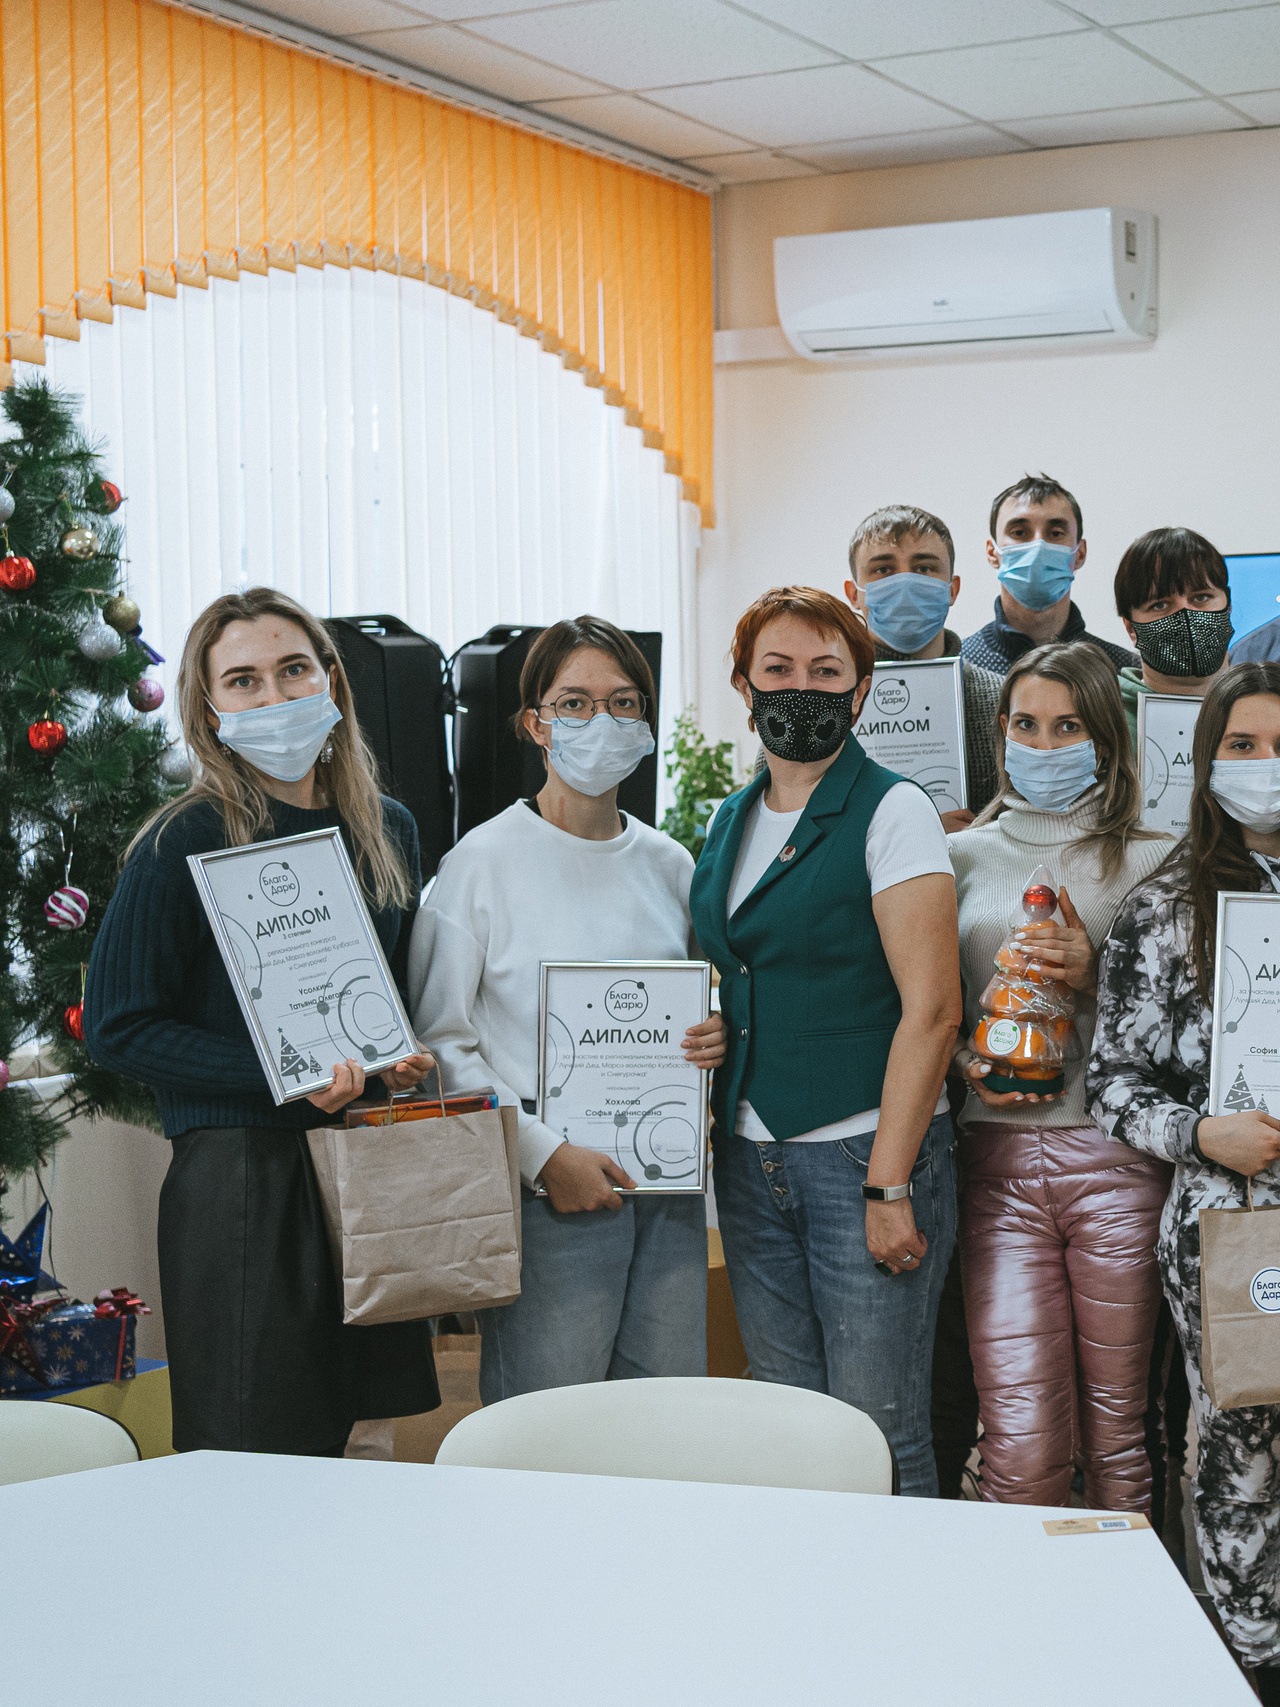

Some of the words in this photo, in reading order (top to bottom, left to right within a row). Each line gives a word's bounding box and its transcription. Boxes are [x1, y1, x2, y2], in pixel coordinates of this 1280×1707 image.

[877, 689, 901, 697] Благо
[881, 697, 906, 705] Дарю
[856, 719, 930, 737] ДИПЛОМ
[262, 875, 288, 886] Благо
[271, 883, 296, 896] Дарю
[256, 905, 331, 940] ДИПЛОМ
[288, 929, 311, 938] степени
[298, 979, 333, 995] Усолкина
[609, 991, 638, 999] Благо
[289, 999, 318, 1010] Татьяна
[613, 1000, 643, 1009] Дарю
[1261, 997, 1276, 1005] Дед
[579, 1029, 668, 1045] ДИПЛОМ
[1249, 1046, 1277, 1055] София
[585, 1109, 612, 1117] Софья
